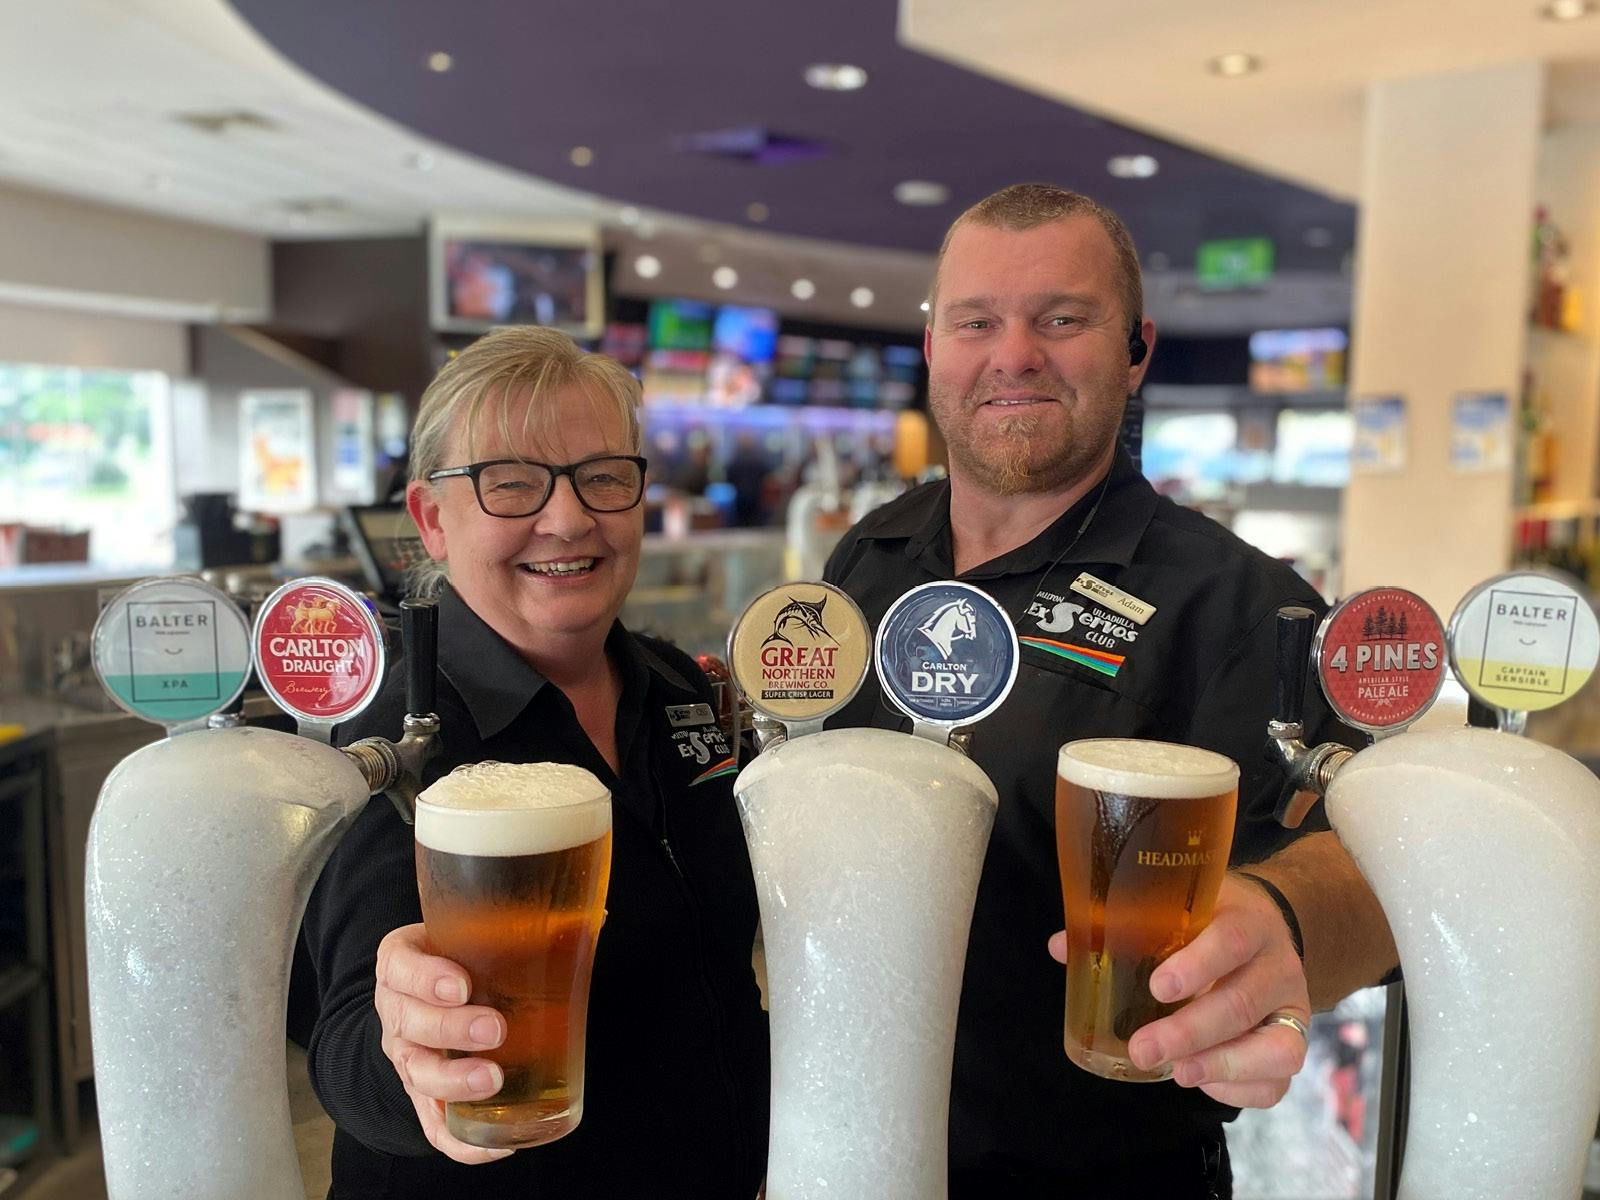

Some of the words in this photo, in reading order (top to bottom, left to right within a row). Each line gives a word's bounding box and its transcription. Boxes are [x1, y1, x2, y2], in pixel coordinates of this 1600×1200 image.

[1117, 597, 1145, 615] Adam
[1496, 603, 1567, 621] BALTER
[136, 615, 208, 628] BALTER
[1092, 607, 1136, 630] ULLADULLA
[1085, 631, 1116, 649] CLUB
[269, 637, 365, 658] CARLTON
[761, 647, 839, 667] GREAT
[1330, 645, 1349, 673] 4
[1355, 642, 1439, 672] PINES
[282, 659, 354, 673] DRAUGHT
[922, 661, 967, 672] CARLTON
[1501, 666, 1547, 677] CAPTAIN
[762, 668, 836, 680] NORTHERN
[1496, 674, 1550, 687] SENSIBLE
[162, 680, 189, 689] XPA
[768, 681, 810, 689] BREWING
[813, 680, 830, 689] CO.
[911, 671, 980, 694] DRY
[1358, 686, 1386, 699] PALE
[1387, 685, 1409, 698] ALE
